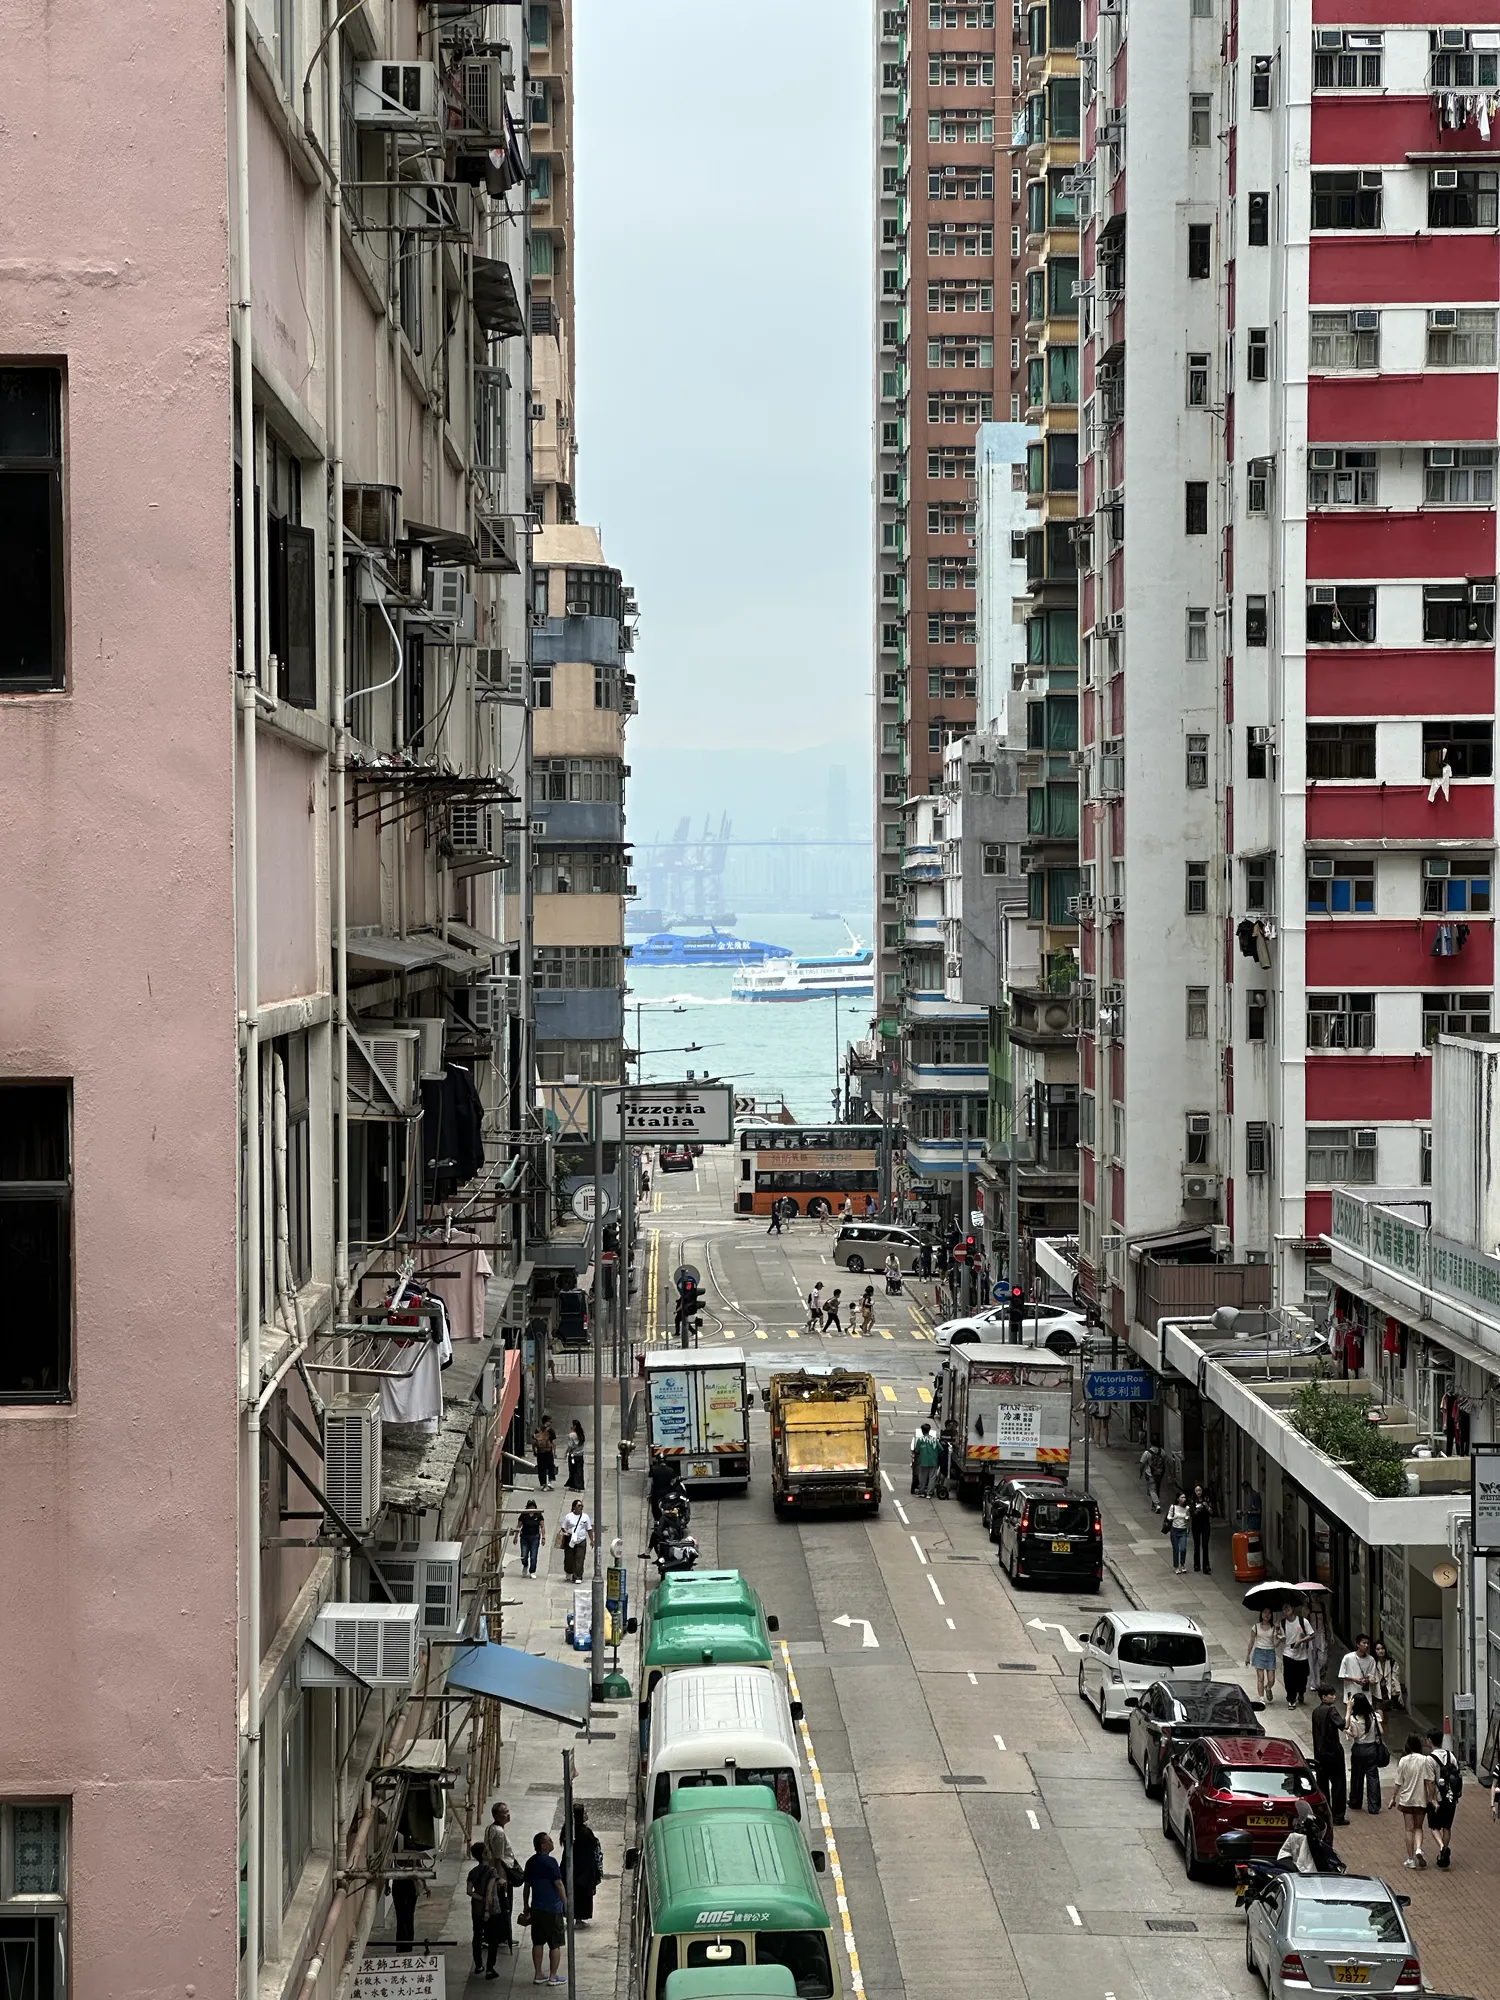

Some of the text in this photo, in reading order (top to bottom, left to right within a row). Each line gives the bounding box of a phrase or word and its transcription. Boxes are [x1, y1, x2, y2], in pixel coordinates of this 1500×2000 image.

[718, 941, 750, 950] 金光飛航
[616, 1103, 706, 1114] Pizzeria
[627, 1116, 695, 1126] Italia
[1093, 1375, 1144, 1383] Victoria Roa
[1094, 1386, 1141, 1397] 域多利道
[1003, 1412, 1021, 1421] 冷凍
[1443, 1571, 1450, 1580] S
[1264, 1817, 1286, 1825] 9076
[696, 1910, 735, 1924] AMS
[734, 1912, 771, 1922] 進智公交
[359, 1956, 438, 1972] 裝飾工程公司
[1345, 1966, 1359, 1974] KV
[1338, 1974, 1367, 1983] 7977
